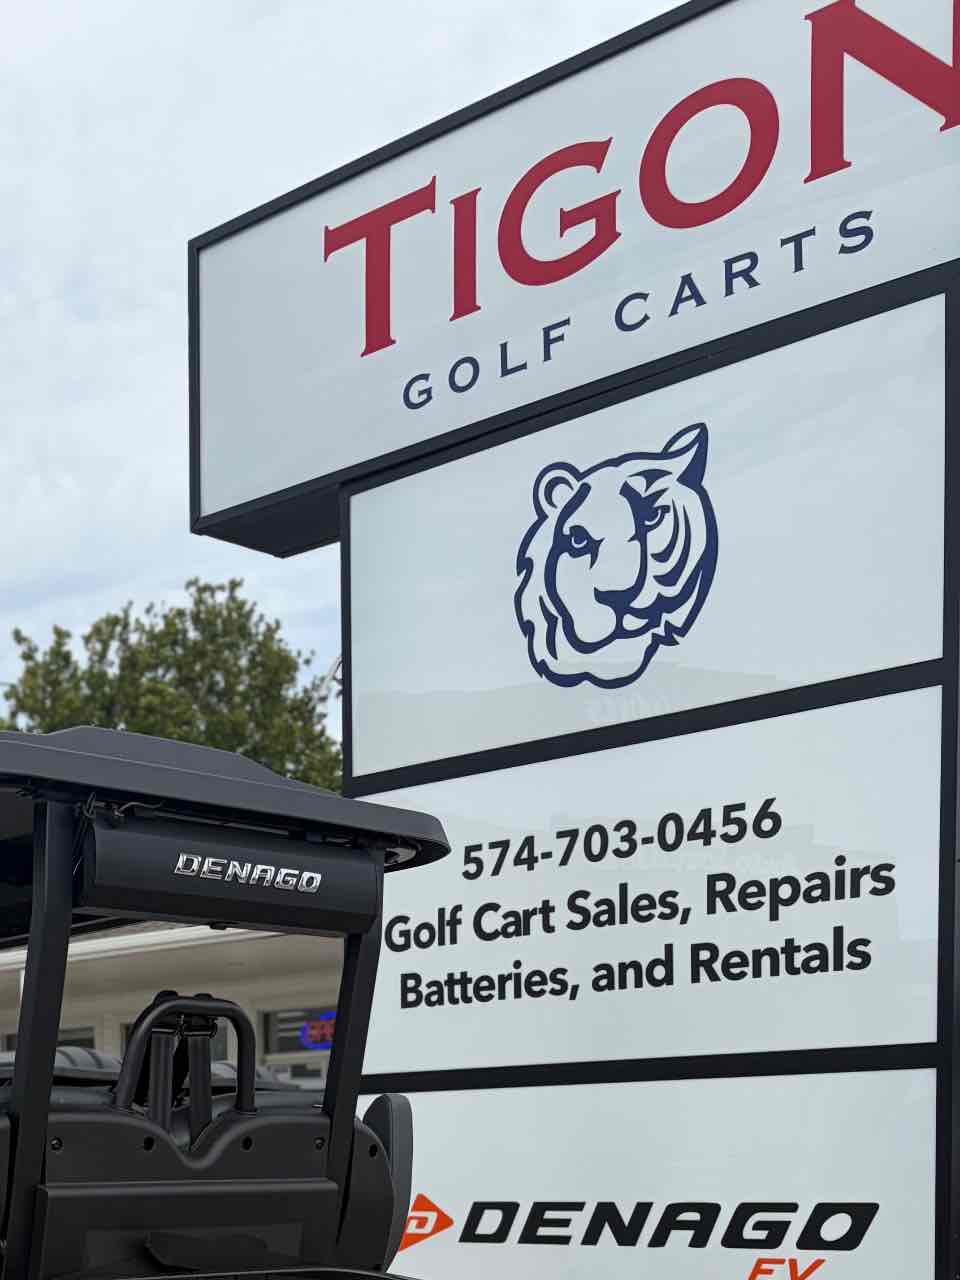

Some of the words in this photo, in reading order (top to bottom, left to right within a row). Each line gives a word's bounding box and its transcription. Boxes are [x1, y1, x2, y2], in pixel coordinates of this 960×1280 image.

[324, 0, 960, 357] TIGON
[402, 317, 572, 410] GOLF
[614, 210, 875, 332] CARTS
[174, 852, 322, 893] DENAGO
[461, 797, 782, 881] 574-703-0456
[384, 903, 463, 953] Golf
[472, 899, 556, 942] Cart
[565, 882, 692, 931] Sales,
[706, 854, 896, 922] Repairs
[400, 959, 580, 1009] Batteries,
[591, 943, 674, 993] and
[690, 925, 872, 985] Rentals
[458, 1201, 880, 1252] DENAGO
